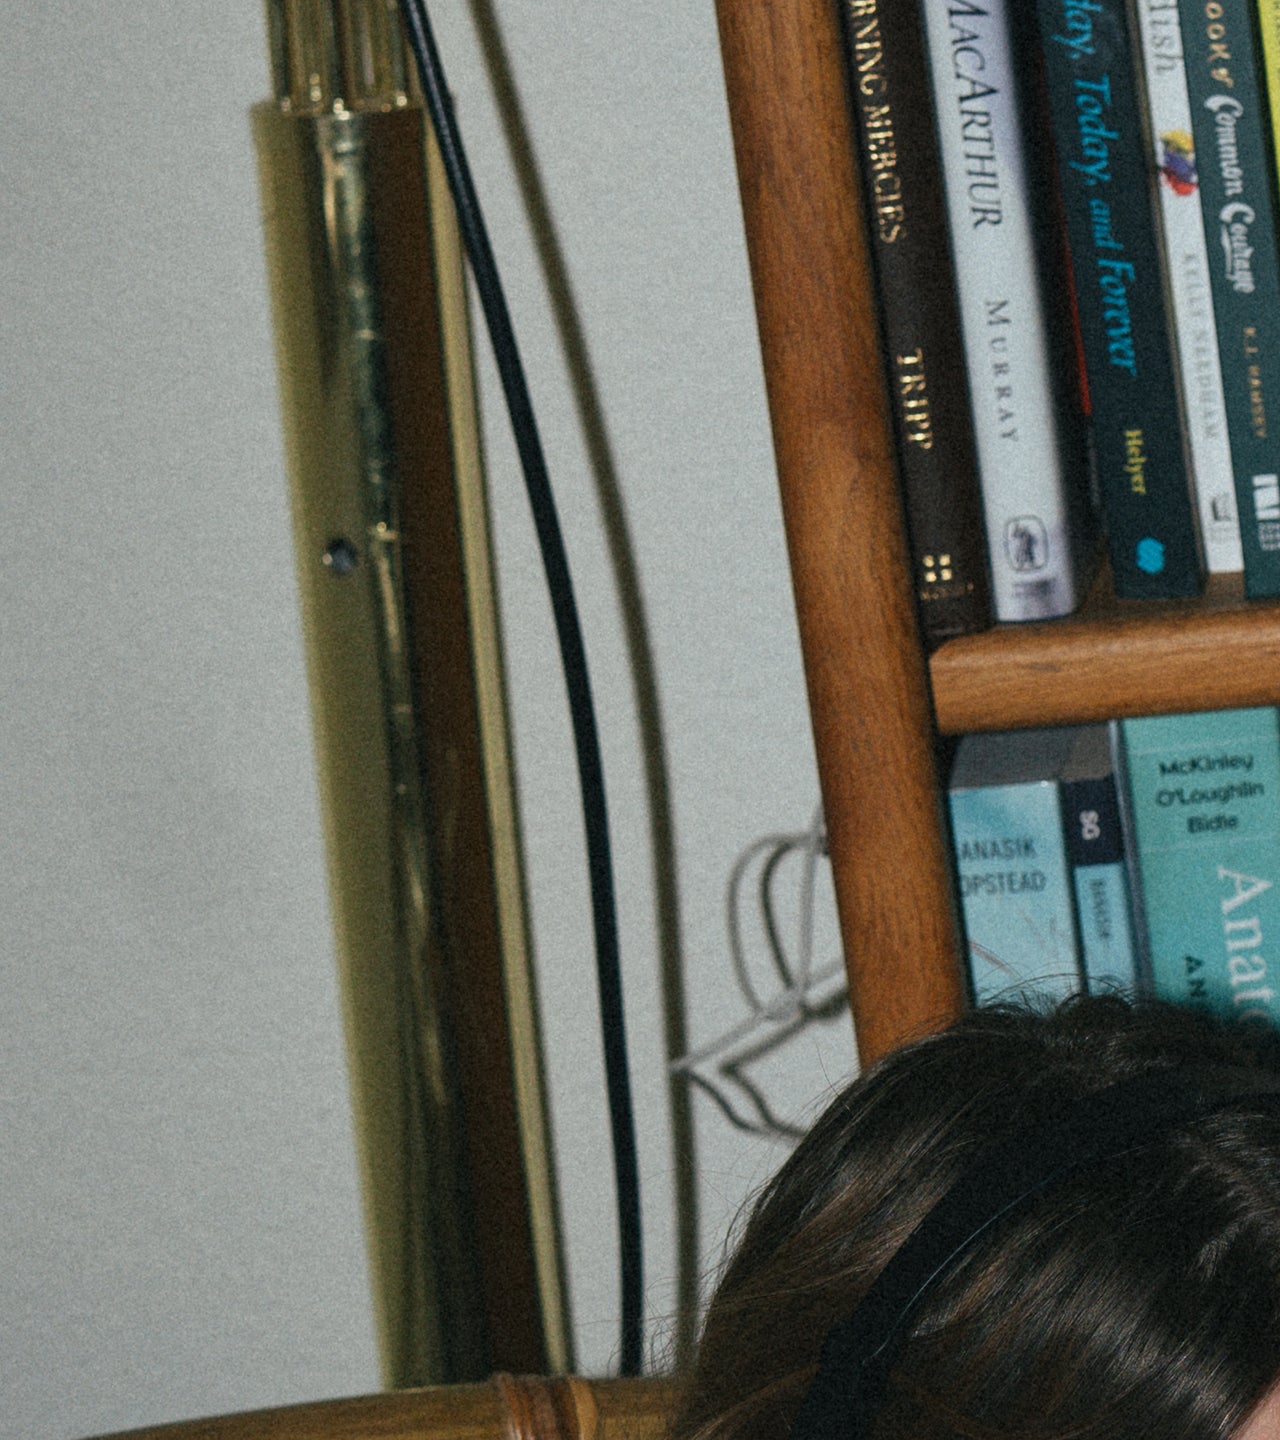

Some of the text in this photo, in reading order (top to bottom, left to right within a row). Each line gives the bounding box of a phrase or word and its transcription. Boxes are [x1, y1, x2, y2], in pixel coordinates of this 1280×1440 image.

[1058, 73, 1123, 189] Today,
[1089, 196, 1123, 251] and
[862, 102, 907, 244] MERCIES
[895, 346, 935, 452] TRIPP
[1095, 255, 1146, 378] Forever
[983, 298, 1025, 444] MURRAY
[1119, 427, 1150, 496] Helyer
[1156, 781, 1264, 808] O'Loughlin
[1159, 754, 1254, 777] McKinley
[1187, 814, 1239, 834] Bidle
